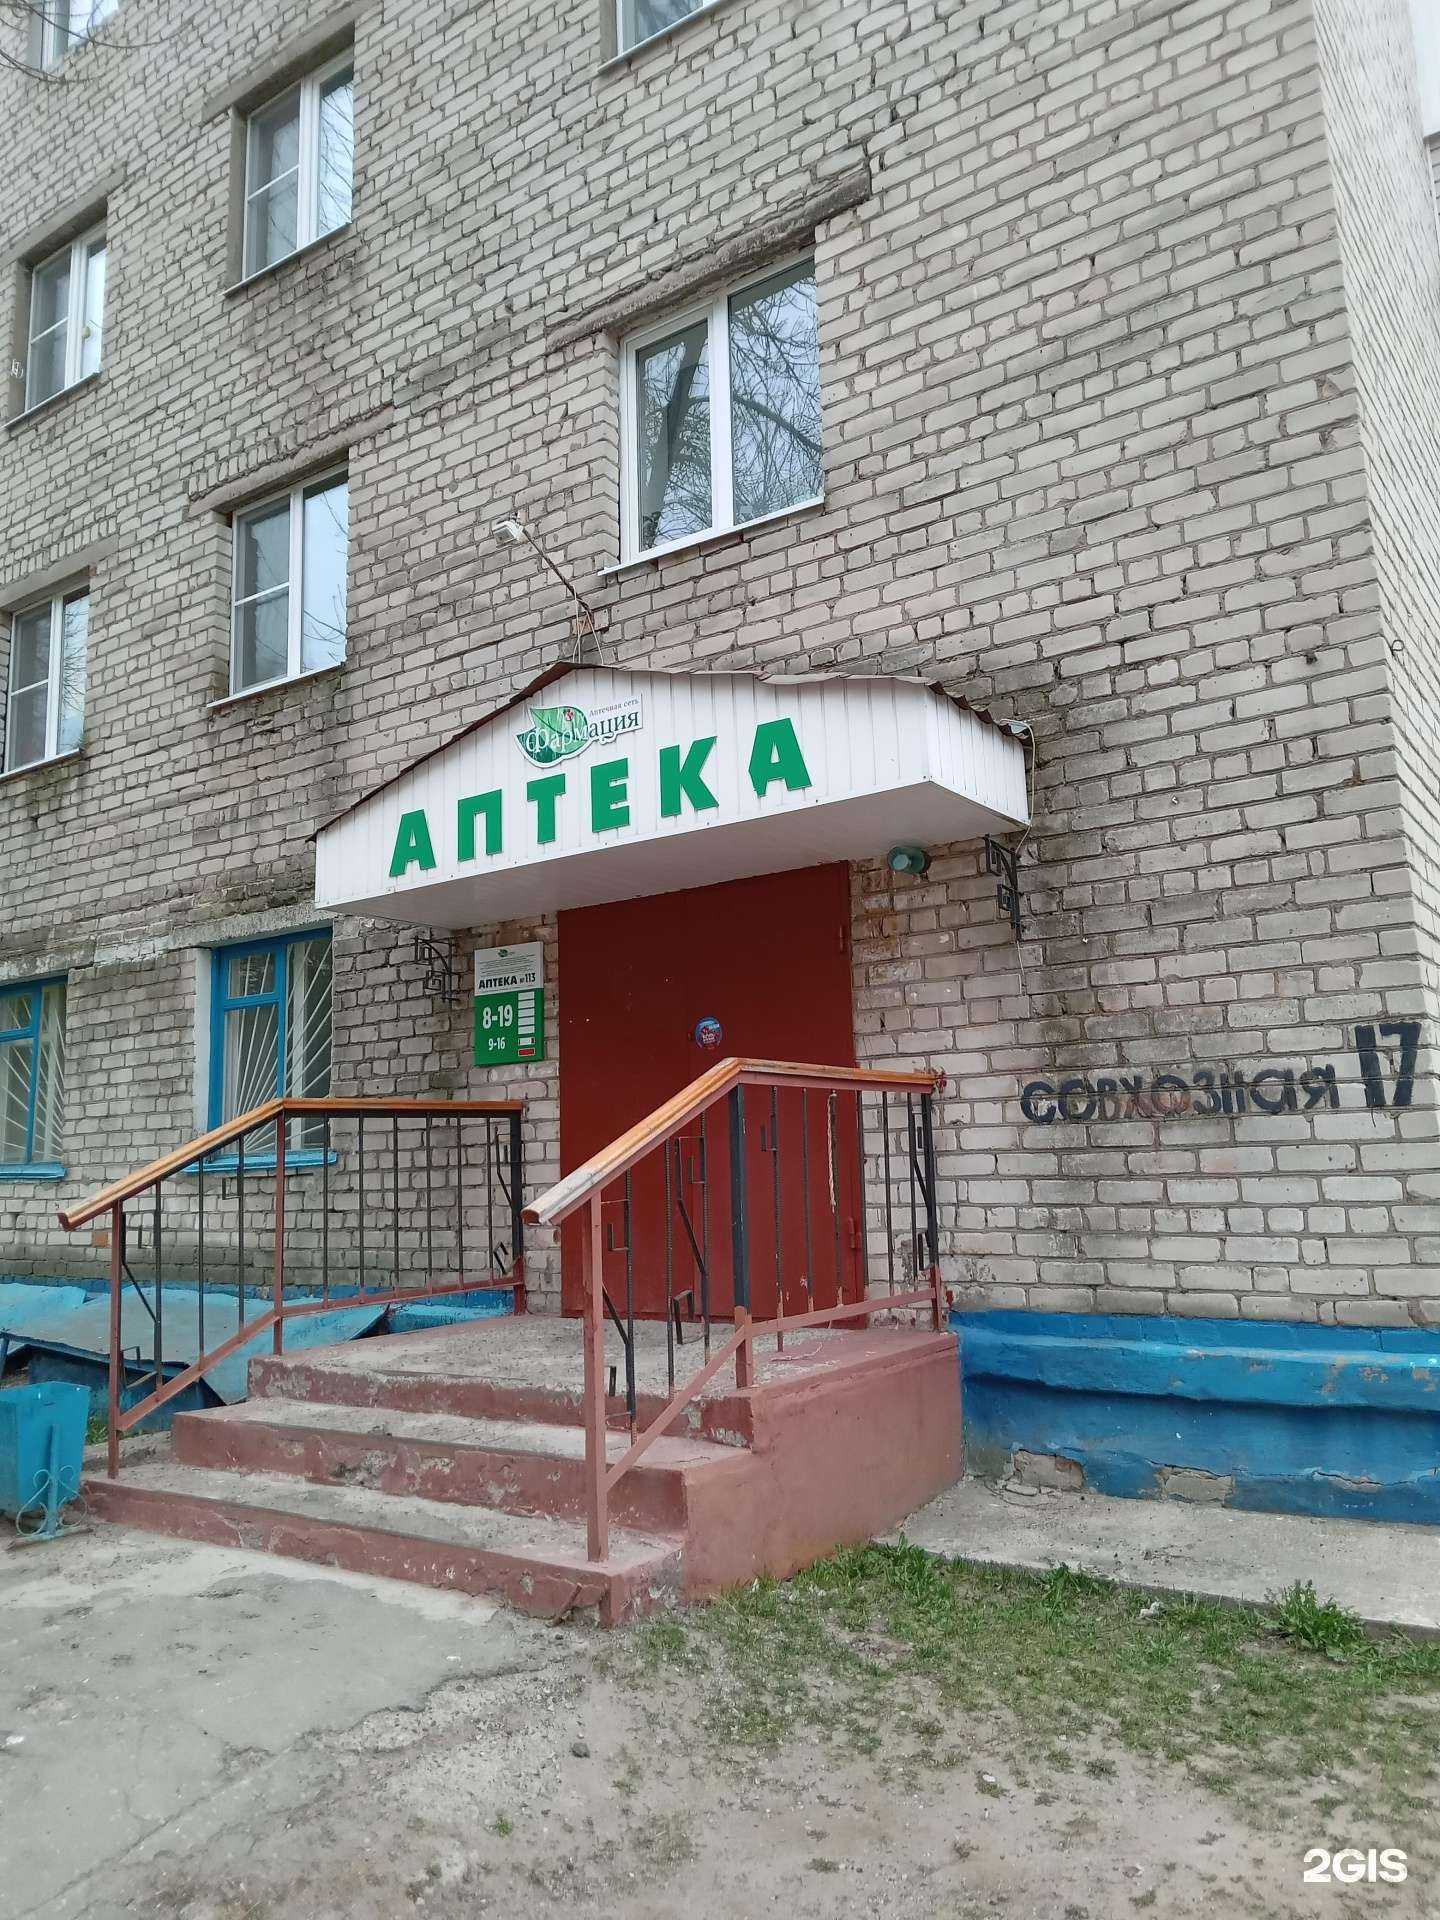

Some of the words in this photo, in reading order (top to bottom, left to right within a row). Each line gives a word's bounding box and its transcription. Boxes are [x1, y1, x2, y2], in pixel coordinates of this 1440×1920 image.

[389, 717, 812, 878] АПТЕКА
[478, 975, 518, 990] АПТЕКА
[482, 1004, 513, 1030] 8-19
[488, 1037, 506, 1051] 9-16
[1355, 1021, 1422, 1108] 17
